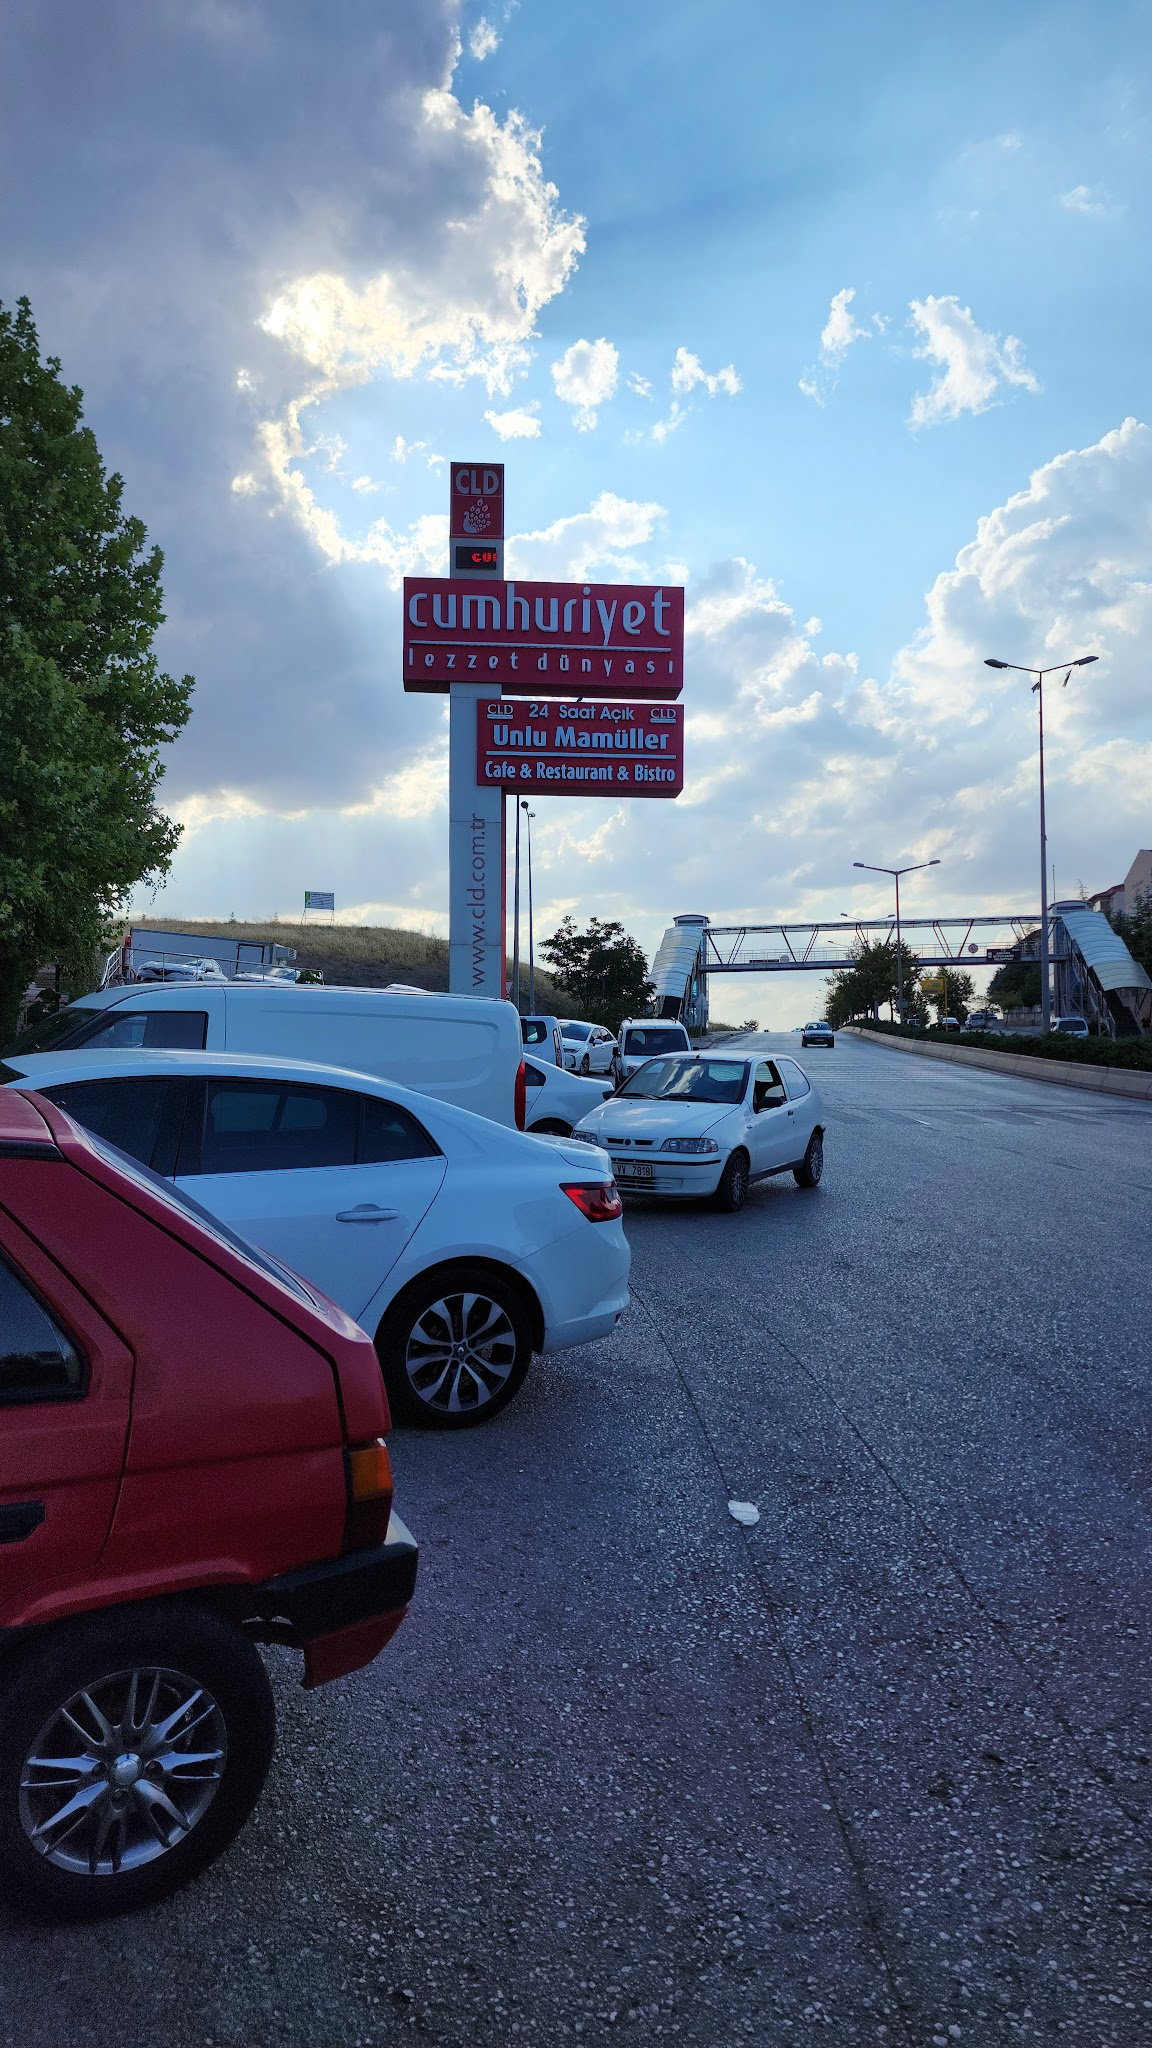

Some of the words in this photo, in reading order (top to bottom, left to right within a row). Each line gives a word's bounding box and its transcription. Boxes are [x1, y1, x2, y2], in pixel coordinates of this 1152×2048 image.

[455, 469, 499, 494] CLD
[409, 583, 671, 647] cumhuriyet
[408, 648, 518, 669] lezzet
[537, 652, 673, 677] dünyası
[487, 704, 513, 715] CLD
[528, 704, 549, 718] 24
[559, 704, 596, 719] Saat
[600, 706, 635, 723] Açık
[650, 708, 676, 718] CLD
[493, 724, 547, 746] Unlu
[554, 726, 669, 749] Mamüller
[485, 761, 516, 778] Cafe
[520, 763, 532, 779] &
[536, 762, 613, 780] Restaurant
[617, 765, 630, 781] &
[634, 764, 676, 781] Bistro
[466, 812, 486, 987] www.cld.com.tr
